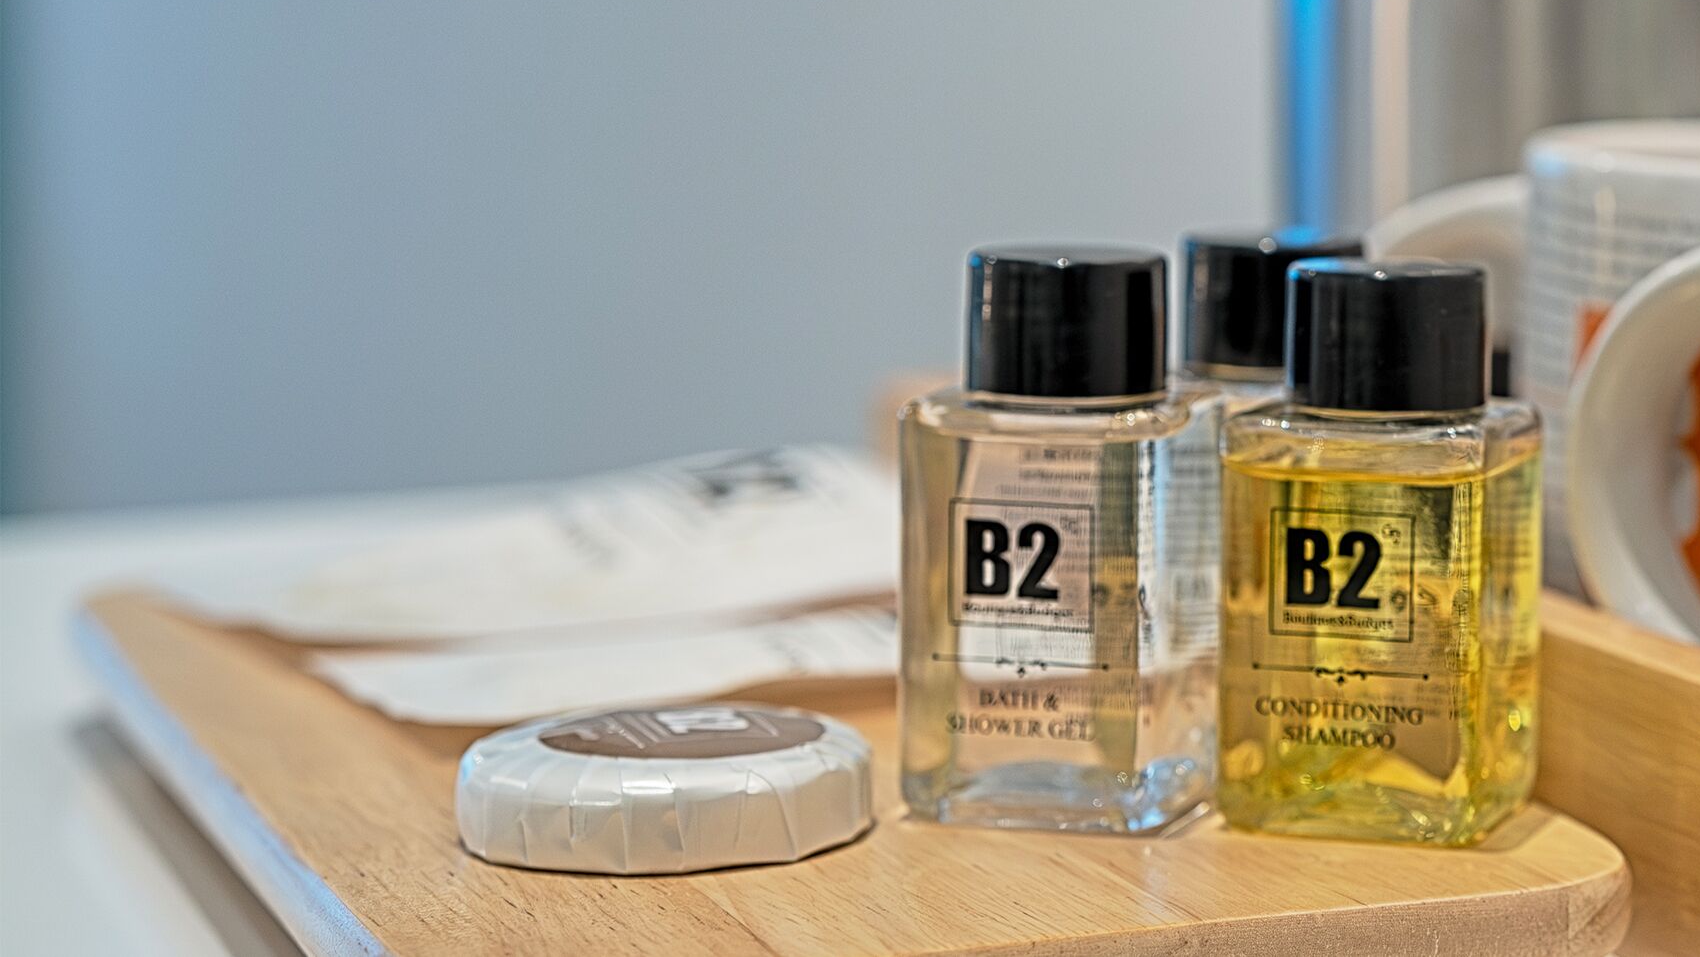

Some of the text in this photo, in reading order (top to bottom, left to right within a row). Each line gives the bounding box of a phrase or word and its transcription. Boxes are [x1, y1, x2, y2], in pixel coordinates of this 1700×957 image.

[964, 518, 1060, 600] B2
[1286, 526, 1382, 610] B2
[979, 689, 1059, 712] BATH &
[1255, 696, 1425, 726] CONDITIONING
[946, 712, 1098, 741] SHOWER GEL
[1282, 725, 1396, 750] SHAMPOO
